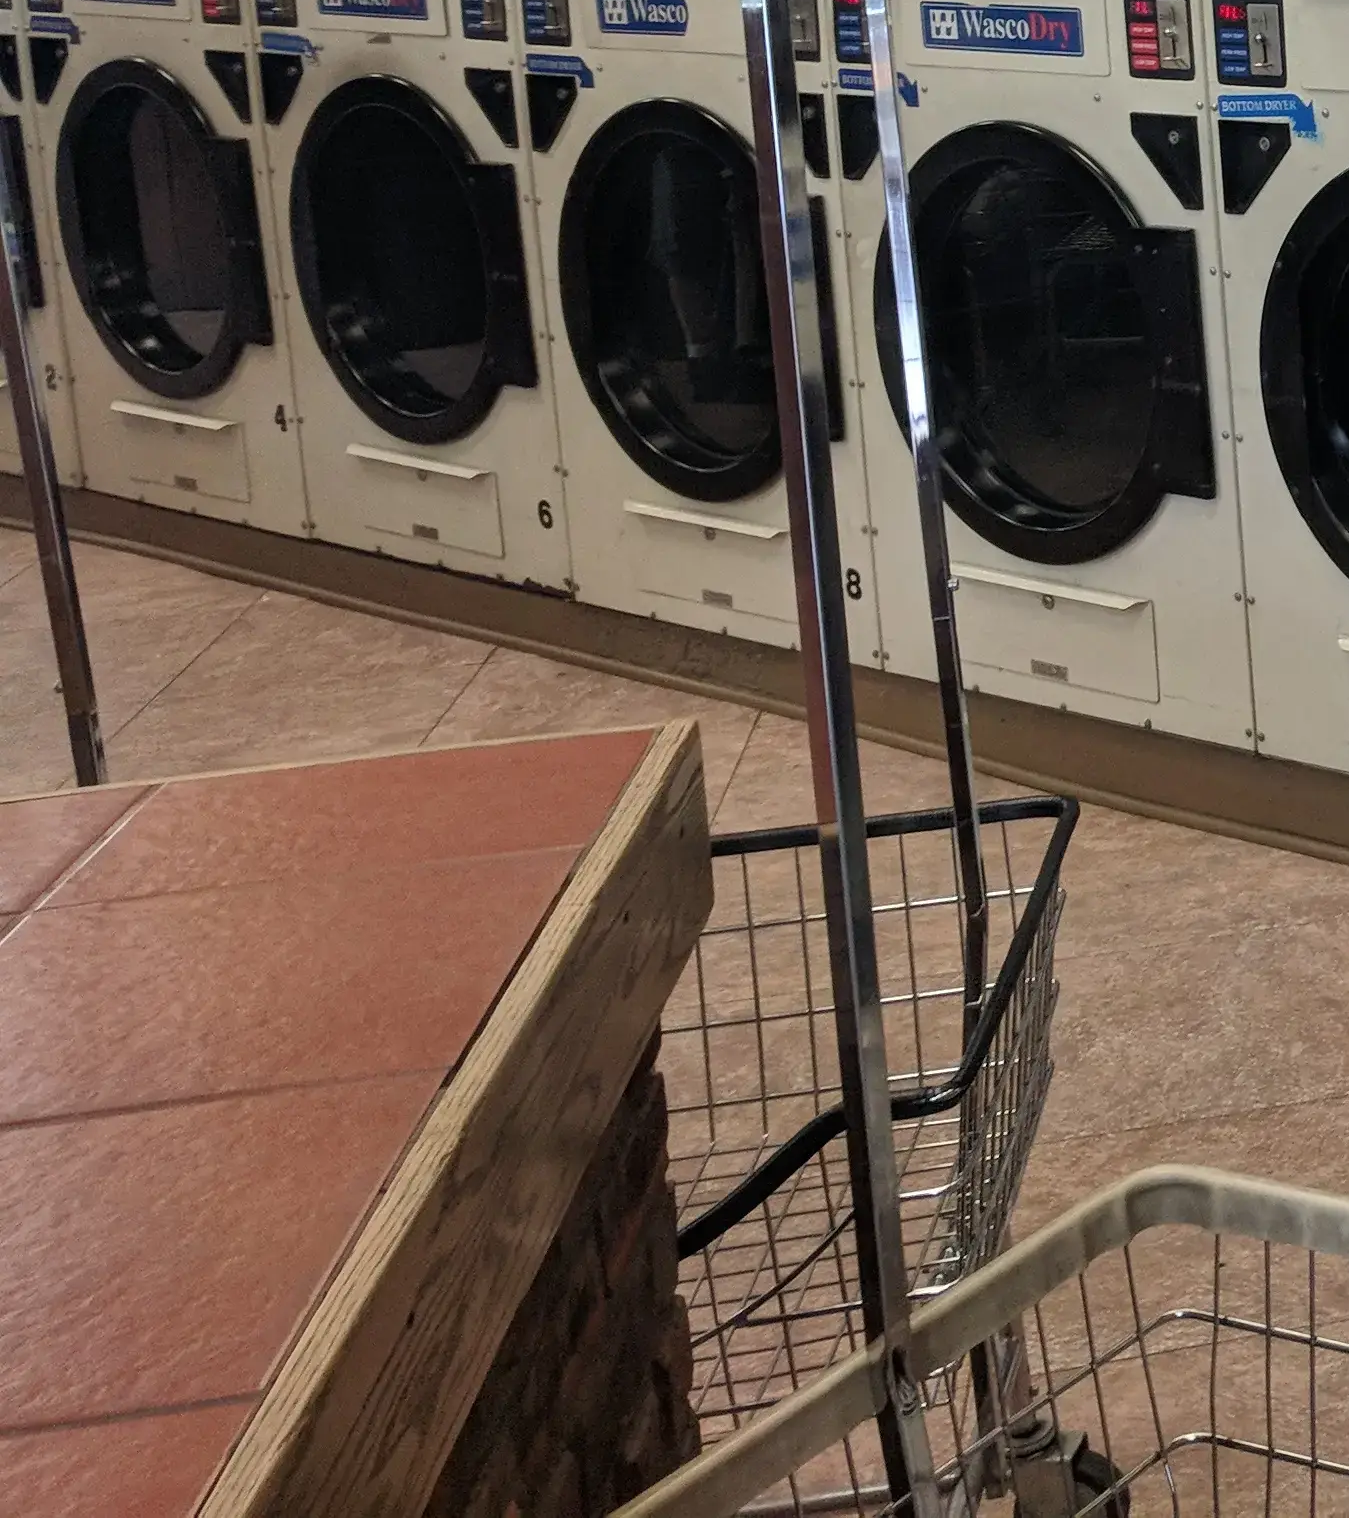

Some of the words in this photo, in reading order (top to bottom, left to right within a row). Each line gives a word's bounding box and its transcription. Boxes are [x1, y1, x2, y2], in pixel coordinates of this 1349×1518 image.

[962, 10, 1071, 49] WascoDry
[1222, 99, 1263, 111] BOTTOM
[1265, 99, 1297, 111] DRYER
[275, 404, 287, 432] 4
[538, 500, 554, 529] 6
[846, 568, 863, 600] 8
